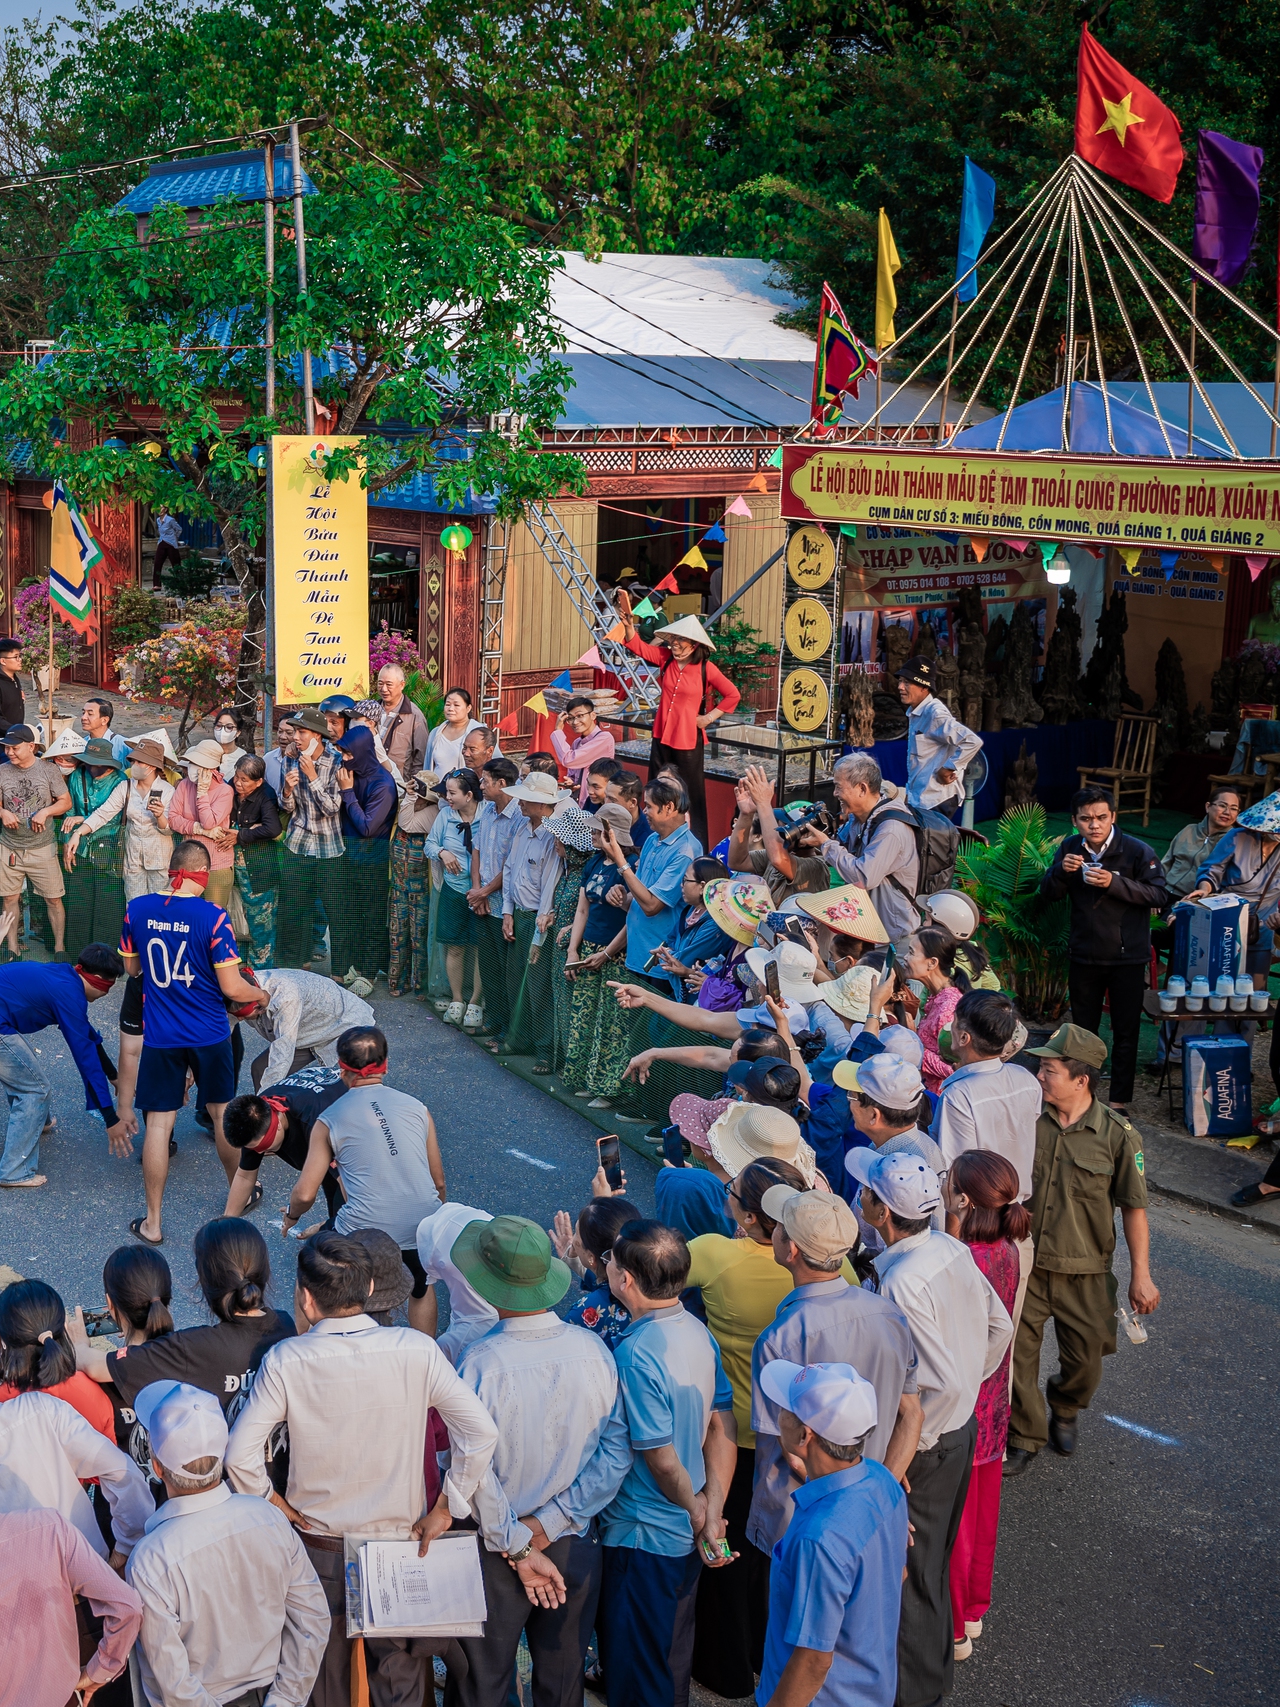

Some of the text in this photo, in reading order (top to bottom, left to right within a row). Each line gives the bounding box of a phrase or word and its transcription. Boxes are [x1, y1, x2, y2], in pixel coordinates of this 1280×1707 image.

[309, 485, 331, 498] Lễ
[810, 457, 824, 493] LỄ
[826, 462, 846, 499] HỘI
[848, 459, 872, 496] BỬU
[874, 460, 900, 497] ĐẢN
[903, 466, 944, 500] THÁNH
[946, 462, 976, 503] MẪU
[979, 470, 996, 510] ĐỆ
[1000, 476, 1028, 506] TAM
[1031, 468, 1072, 509] THOẢI
[1075, 480, 1115, 511] CUNG
[1118, 476, 1181, 516] PHƯỜNG
[1185, 478, 1216, 518] HÒA
[1220, 481, 1268, 521] XUÂN
[306, 506, 338, 522] Hội
[303, 528, 338, 540] Bửu
[868, 506, 1264, 546] CỤM DÂN CƯ SỐ 3: MIẾU BÔNG, CỒN MONG, QUÁ GIÁNG 1, QUÁ GIÁNG 2
[302, 548, 340, 562] Đản
[859, 547, 914, 572] THẬP
[918, 546, 961, 570] VẠN
[294, 568, 349, 583] Thánh
[886, 580, 898, 590] ĐT:
[899, 578, 918, 590] 0975
[920, 577, 934, 589] 014
[936, 576, 950, 588] 108
[956, 574, 975, 586] 0702
[976, 574, 990, 585] 528
[992, 572, 1006, 584] 644
[1142, 566, 1165, 579] BÔNG
[1192, 570, 1218, 584] MONG
[302, 590, 340, 604] Mẫu
[905, 594, 923, 605] Trung
[1132, 581, 1156, 595] GIÁNG
[1157, 585, 1162, 596] 1
[1170, 584, 1187, 598] QUÁ
[1189, 586, 1216, 600] GIÁNG
[1218, 590, 1224, 601] 2
[310, 610, 334, 626] Đệ
[798, 608, 817, 630] Vạn
[304, 632, 341, 645] Tam
[799, 634, 818, 652] Vật
[298, 652, 347, 666] Thoải
[302, 673, 342, 688] Cung
[792, 678, 818, 698] Bách
[914, 676, 932, 687] CELINE
[147, 918, 190, 933] Phạm Bảo
[1222, 926, 1234, 978] AQUAFINA
[146, 937, 196, 988] 04
[1216, 1066, 1234, 1120] AQUAFINA
[370, 1101, 398, 1156] NIKE RUNNING
[224, 1368, 256, 1392] ĐỨ
